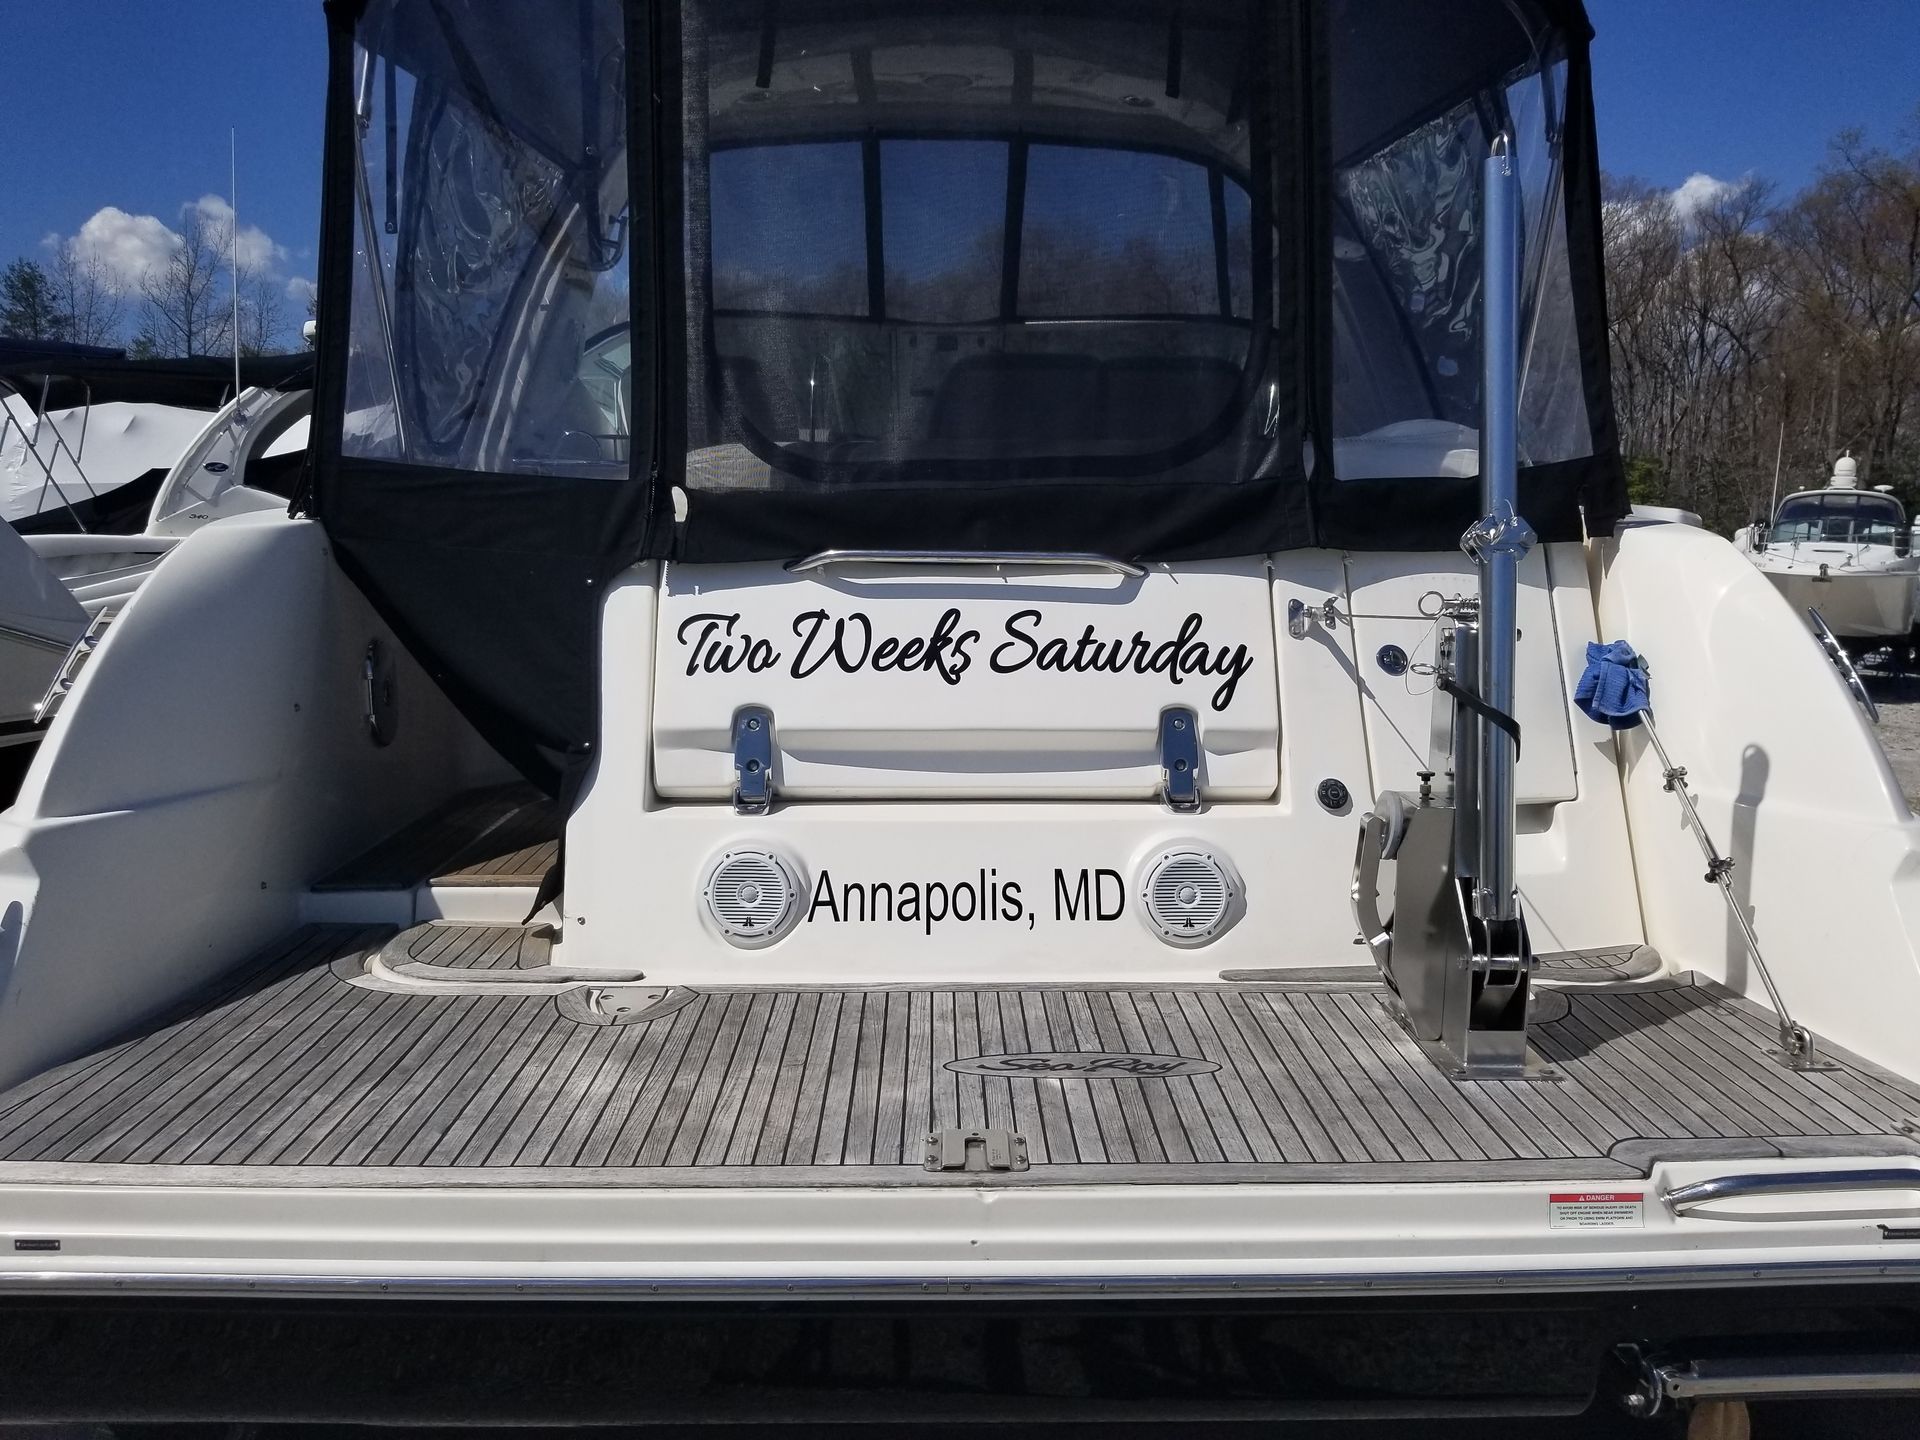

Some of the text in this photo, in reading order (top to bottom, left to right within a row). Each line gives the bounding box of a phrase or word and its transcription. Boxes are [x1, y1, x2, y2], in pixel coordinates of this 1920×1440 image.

[677, 608, 1254, 712] Two Weeks Saturday
[807, 868, 1126, 936] Annapolis, MD
[977, 1057, 1188, 1074] Sea Ray
